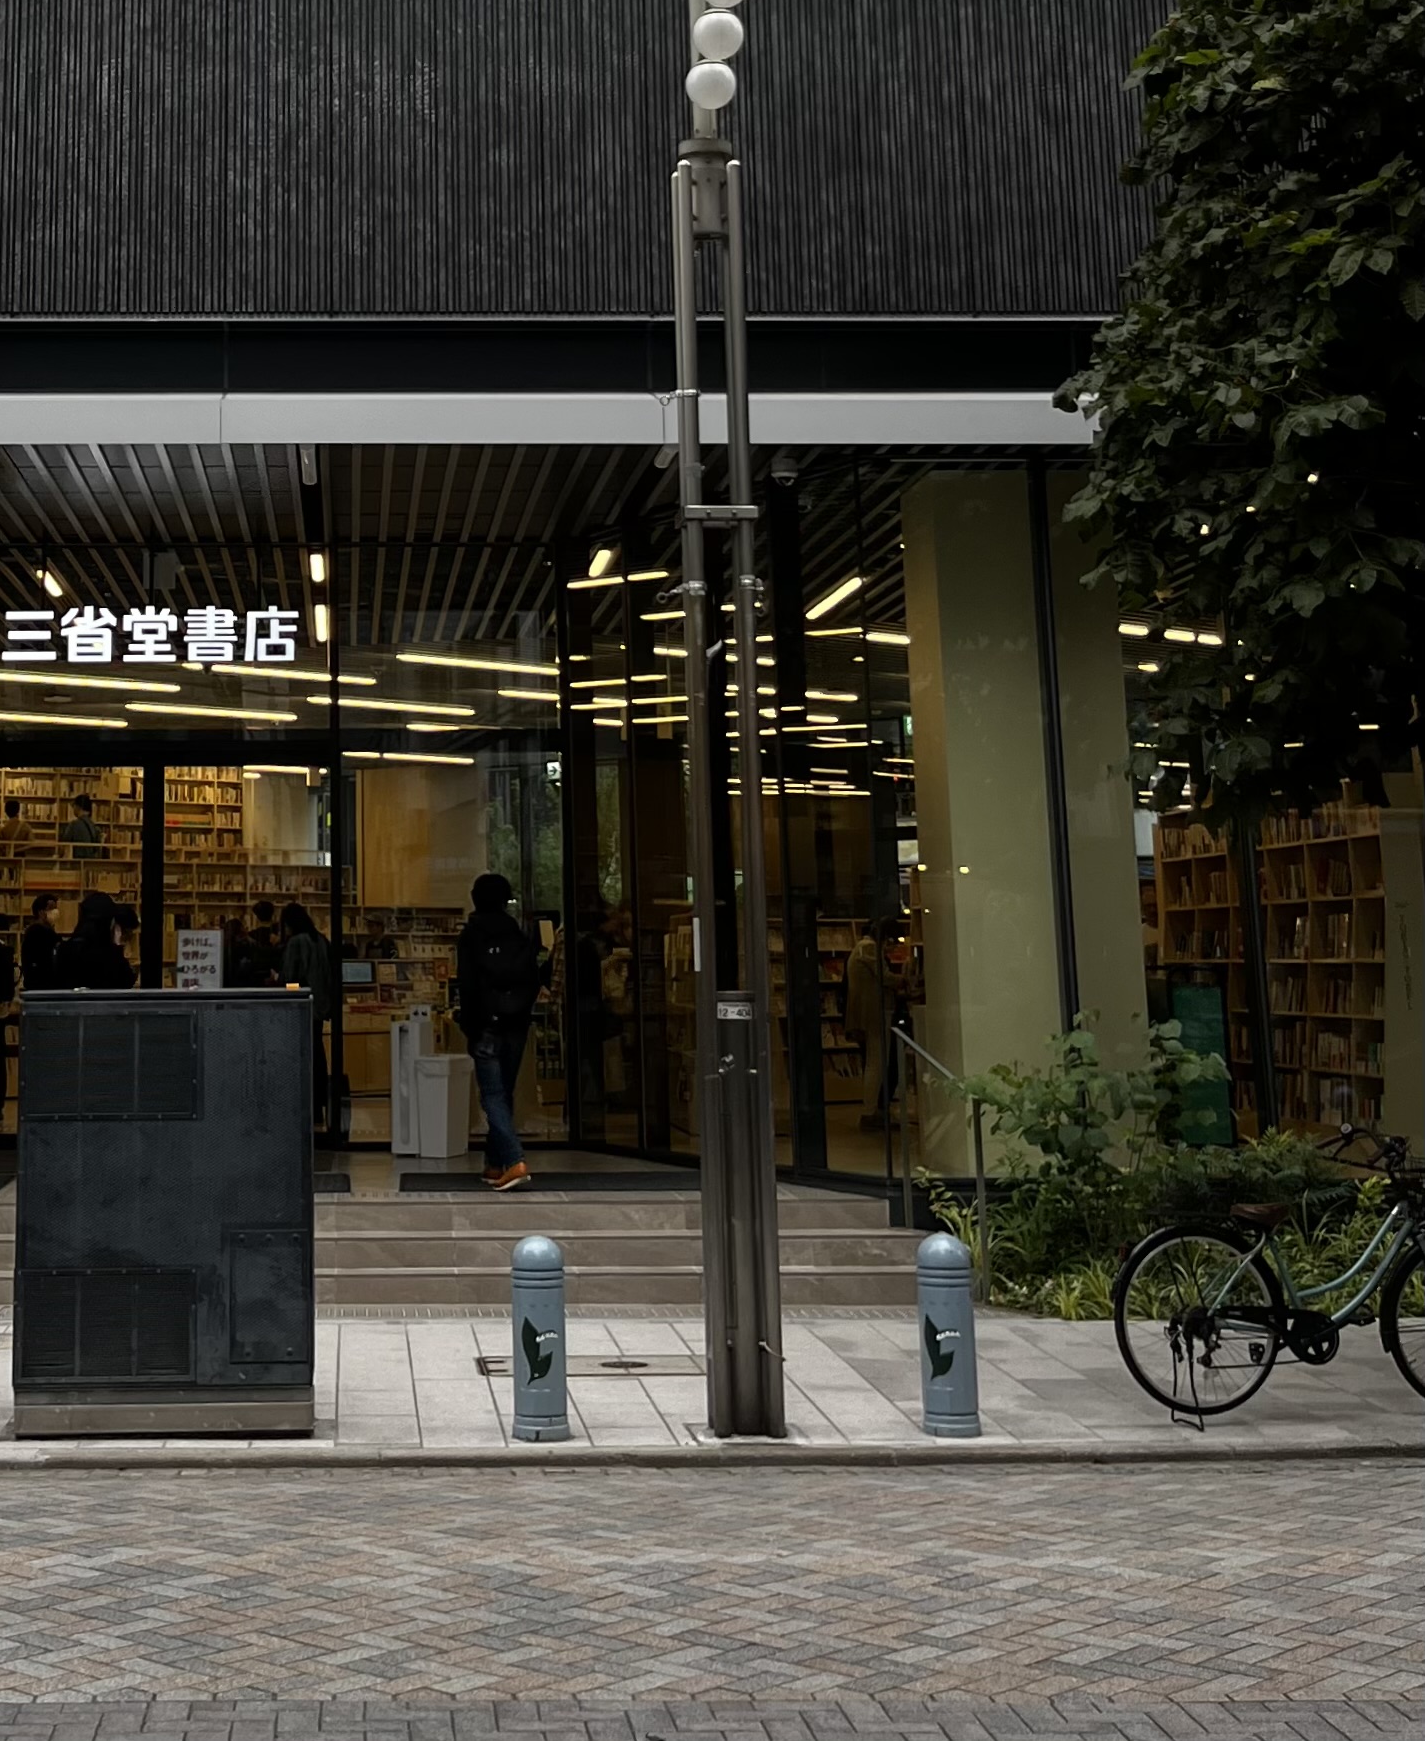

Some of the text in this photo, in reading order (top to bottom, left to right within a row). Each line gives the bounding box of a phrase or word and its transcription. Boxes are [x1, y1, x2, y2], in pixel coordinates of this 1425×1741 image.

[1, 605, 300, 663] 三省堂書店
